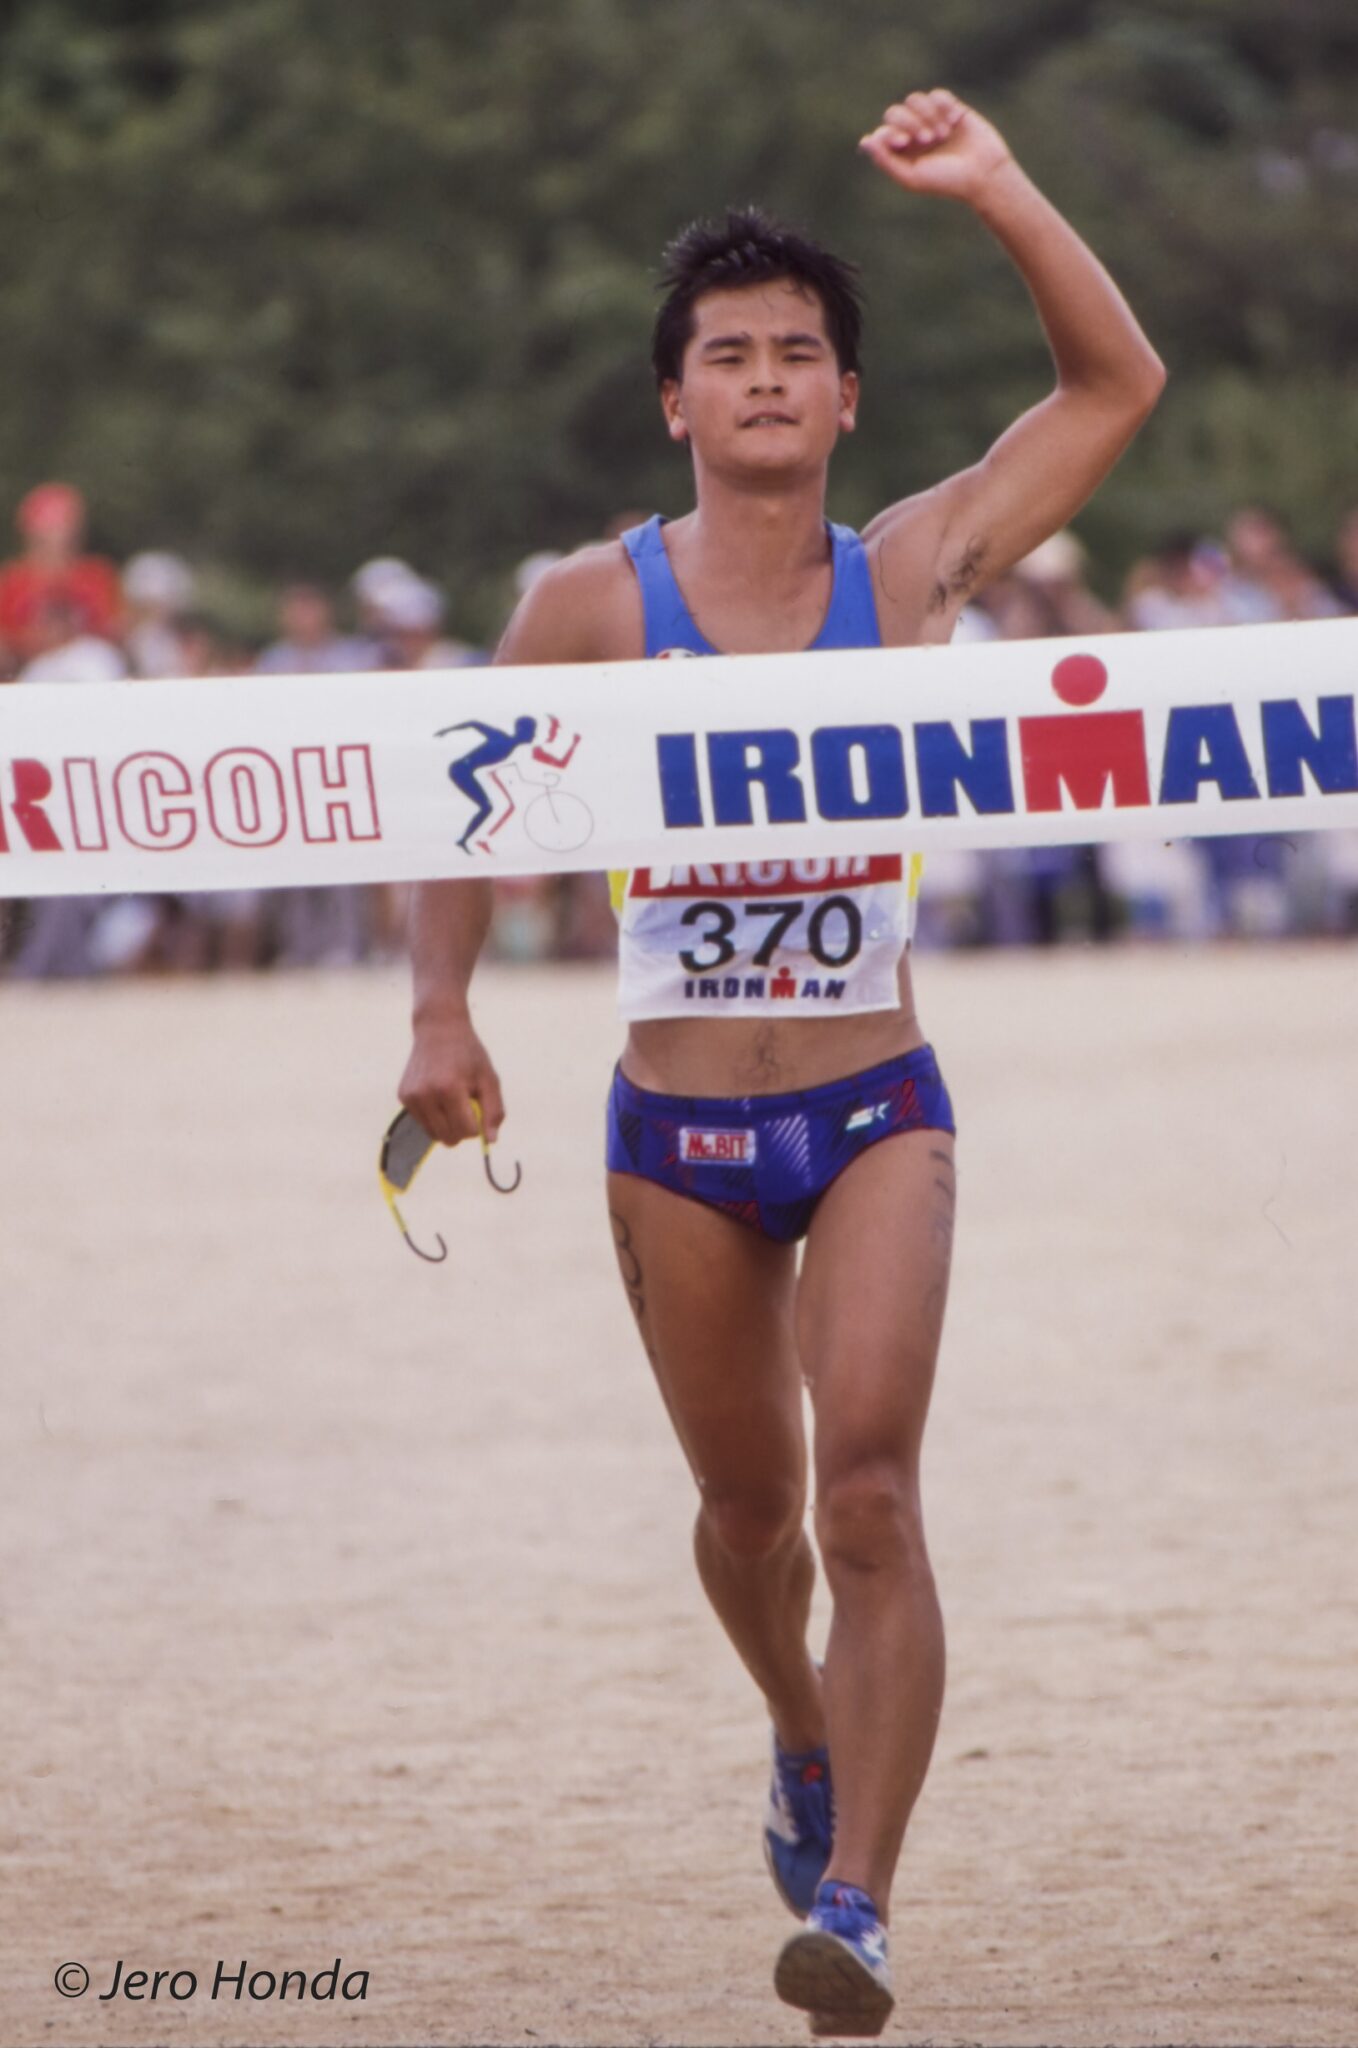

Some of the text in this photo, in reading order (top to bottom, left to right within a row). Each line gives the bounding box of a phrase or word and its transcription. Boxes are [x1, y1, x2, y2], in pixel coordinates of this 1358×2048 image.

[0, 653, 1358, 854] RICOH IRONMAN
[679, 895, 862, 973] 370
[684, 966, 847, 1000] IRONMAN
